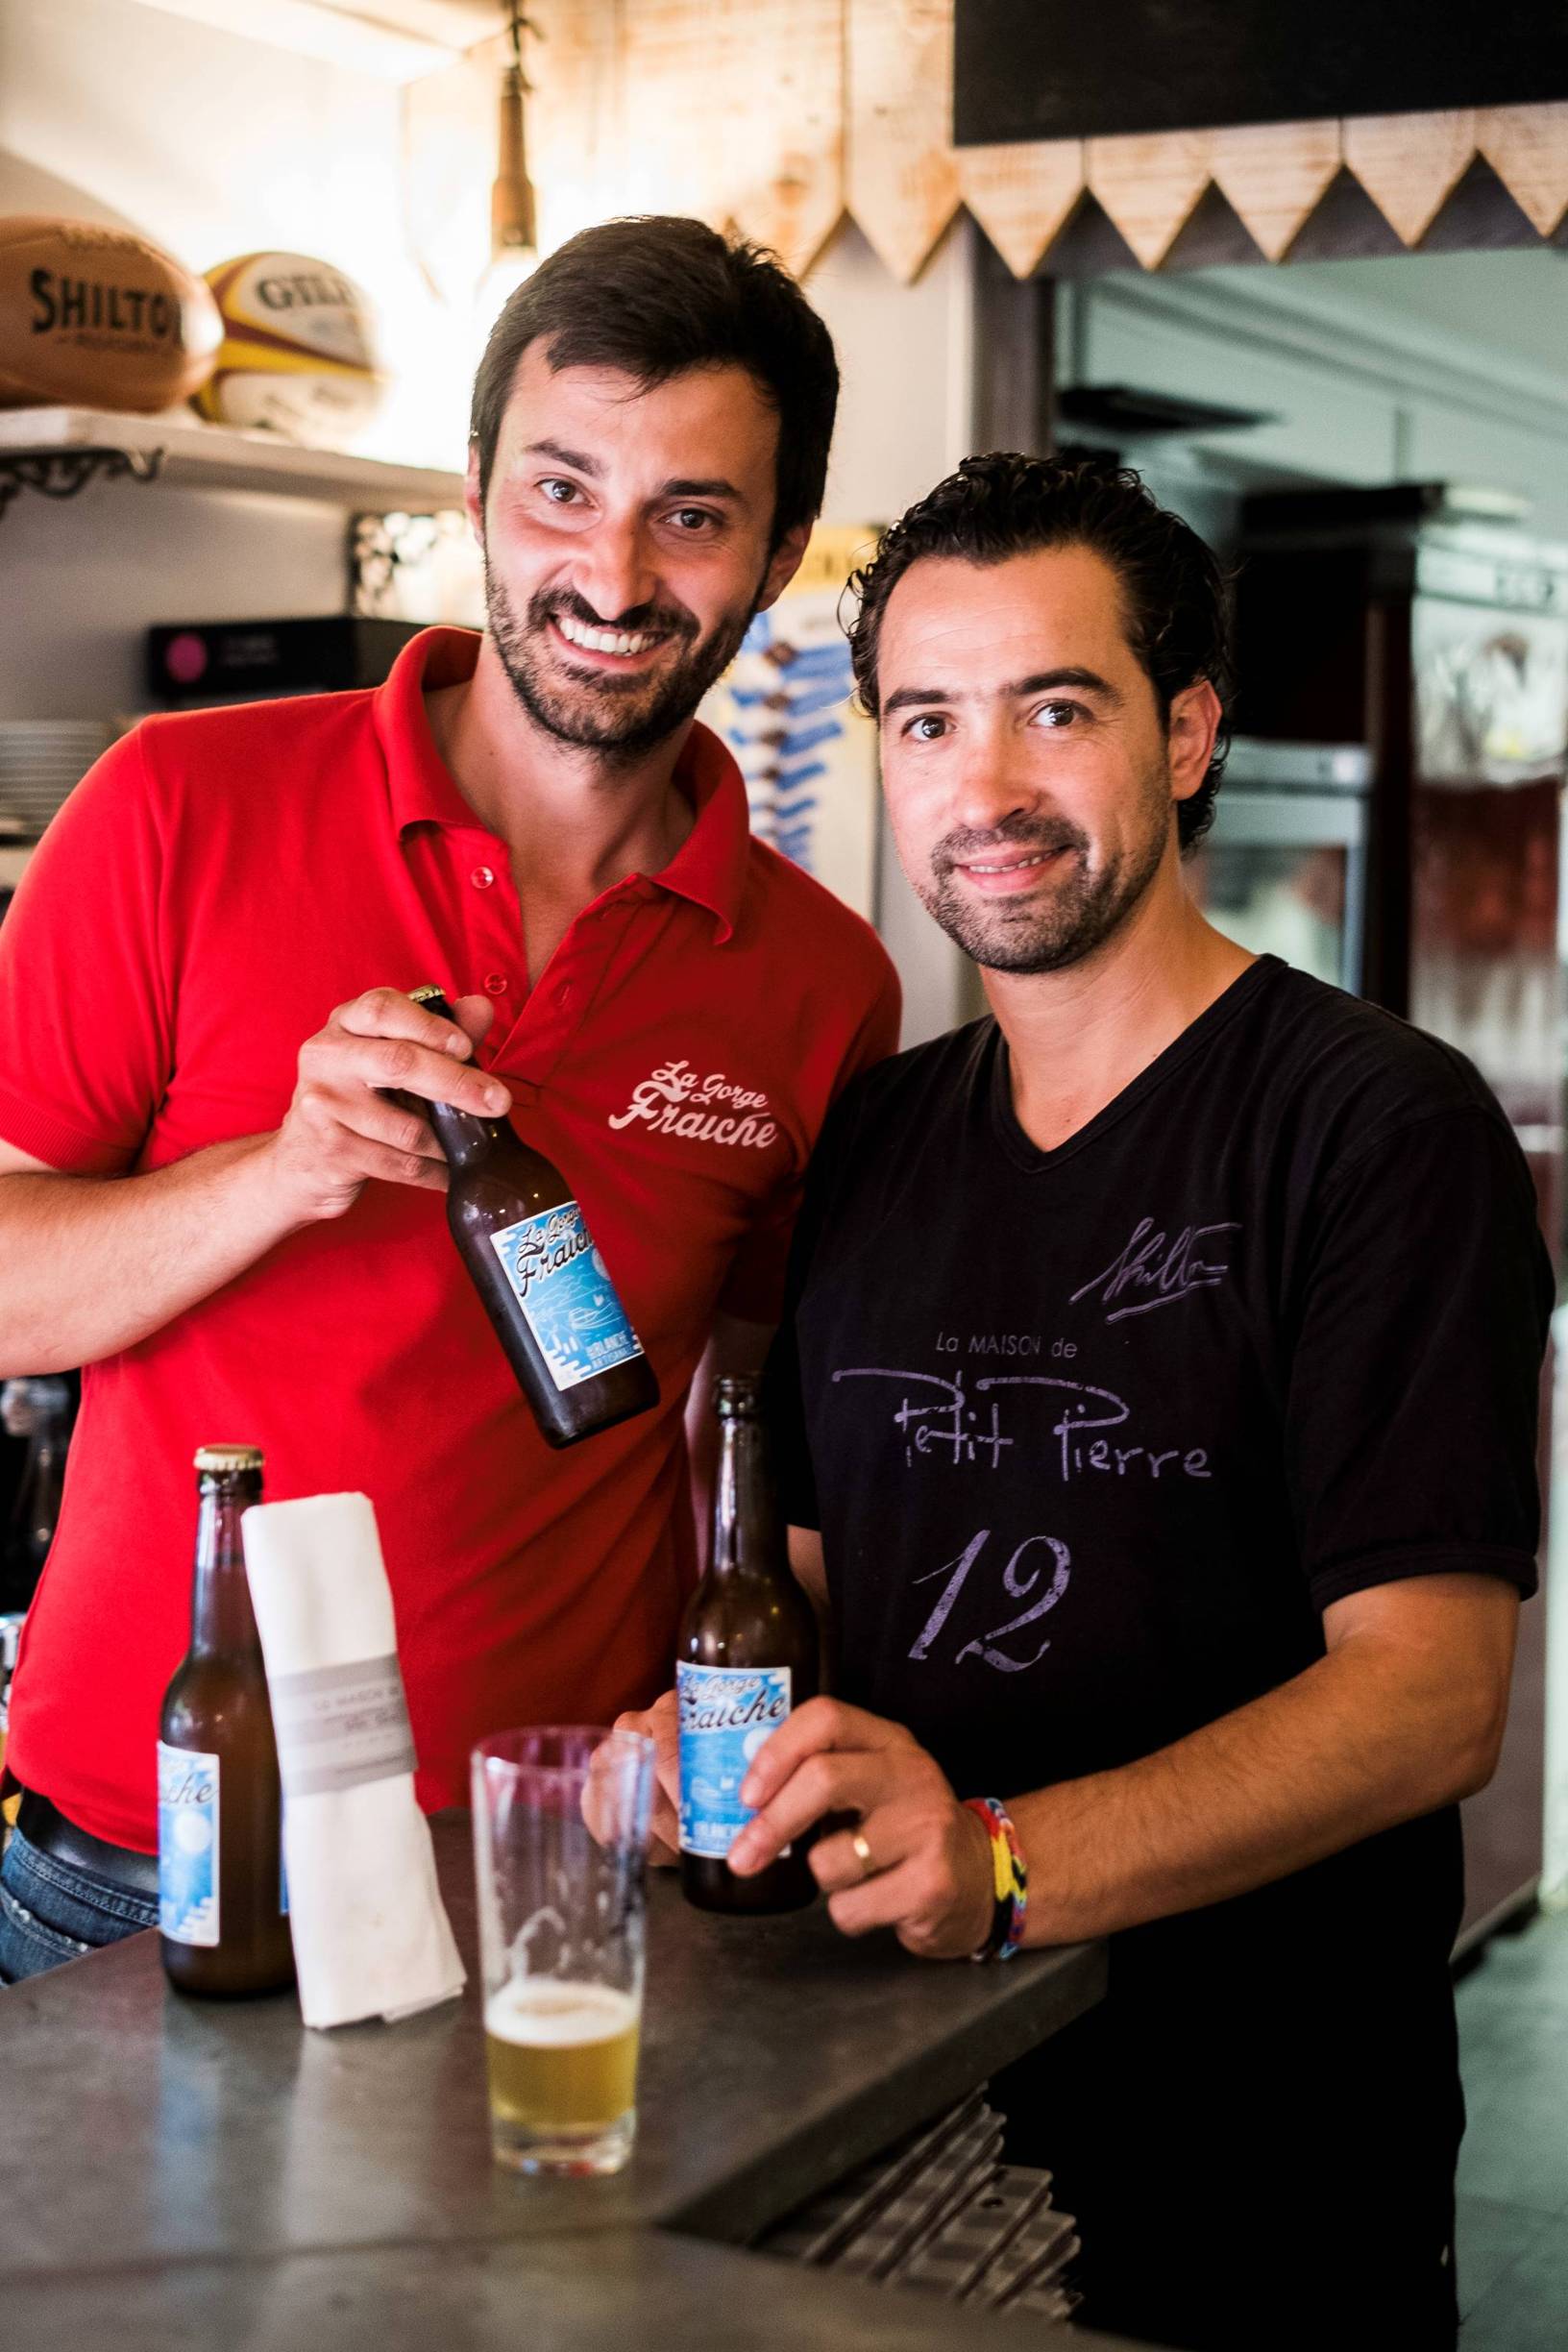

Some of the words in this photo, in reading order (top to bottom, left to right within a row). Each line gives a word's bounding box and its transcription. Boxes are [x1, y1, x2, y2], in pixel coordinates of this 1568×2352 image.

[650, 1060, 698, 1093] La
[690, 1073, 769, 1109] Gorge
[935, 1332, 959, 1353] La
[968, 1334, 1041, 1356] MAISON
[1051, 1336, 1078, 1359] de
[832, 1368, 1014, 1468] Petit
[976, 1376, 1212, 1481] Pierre
[908, 1530, 1071, 1672] 12
